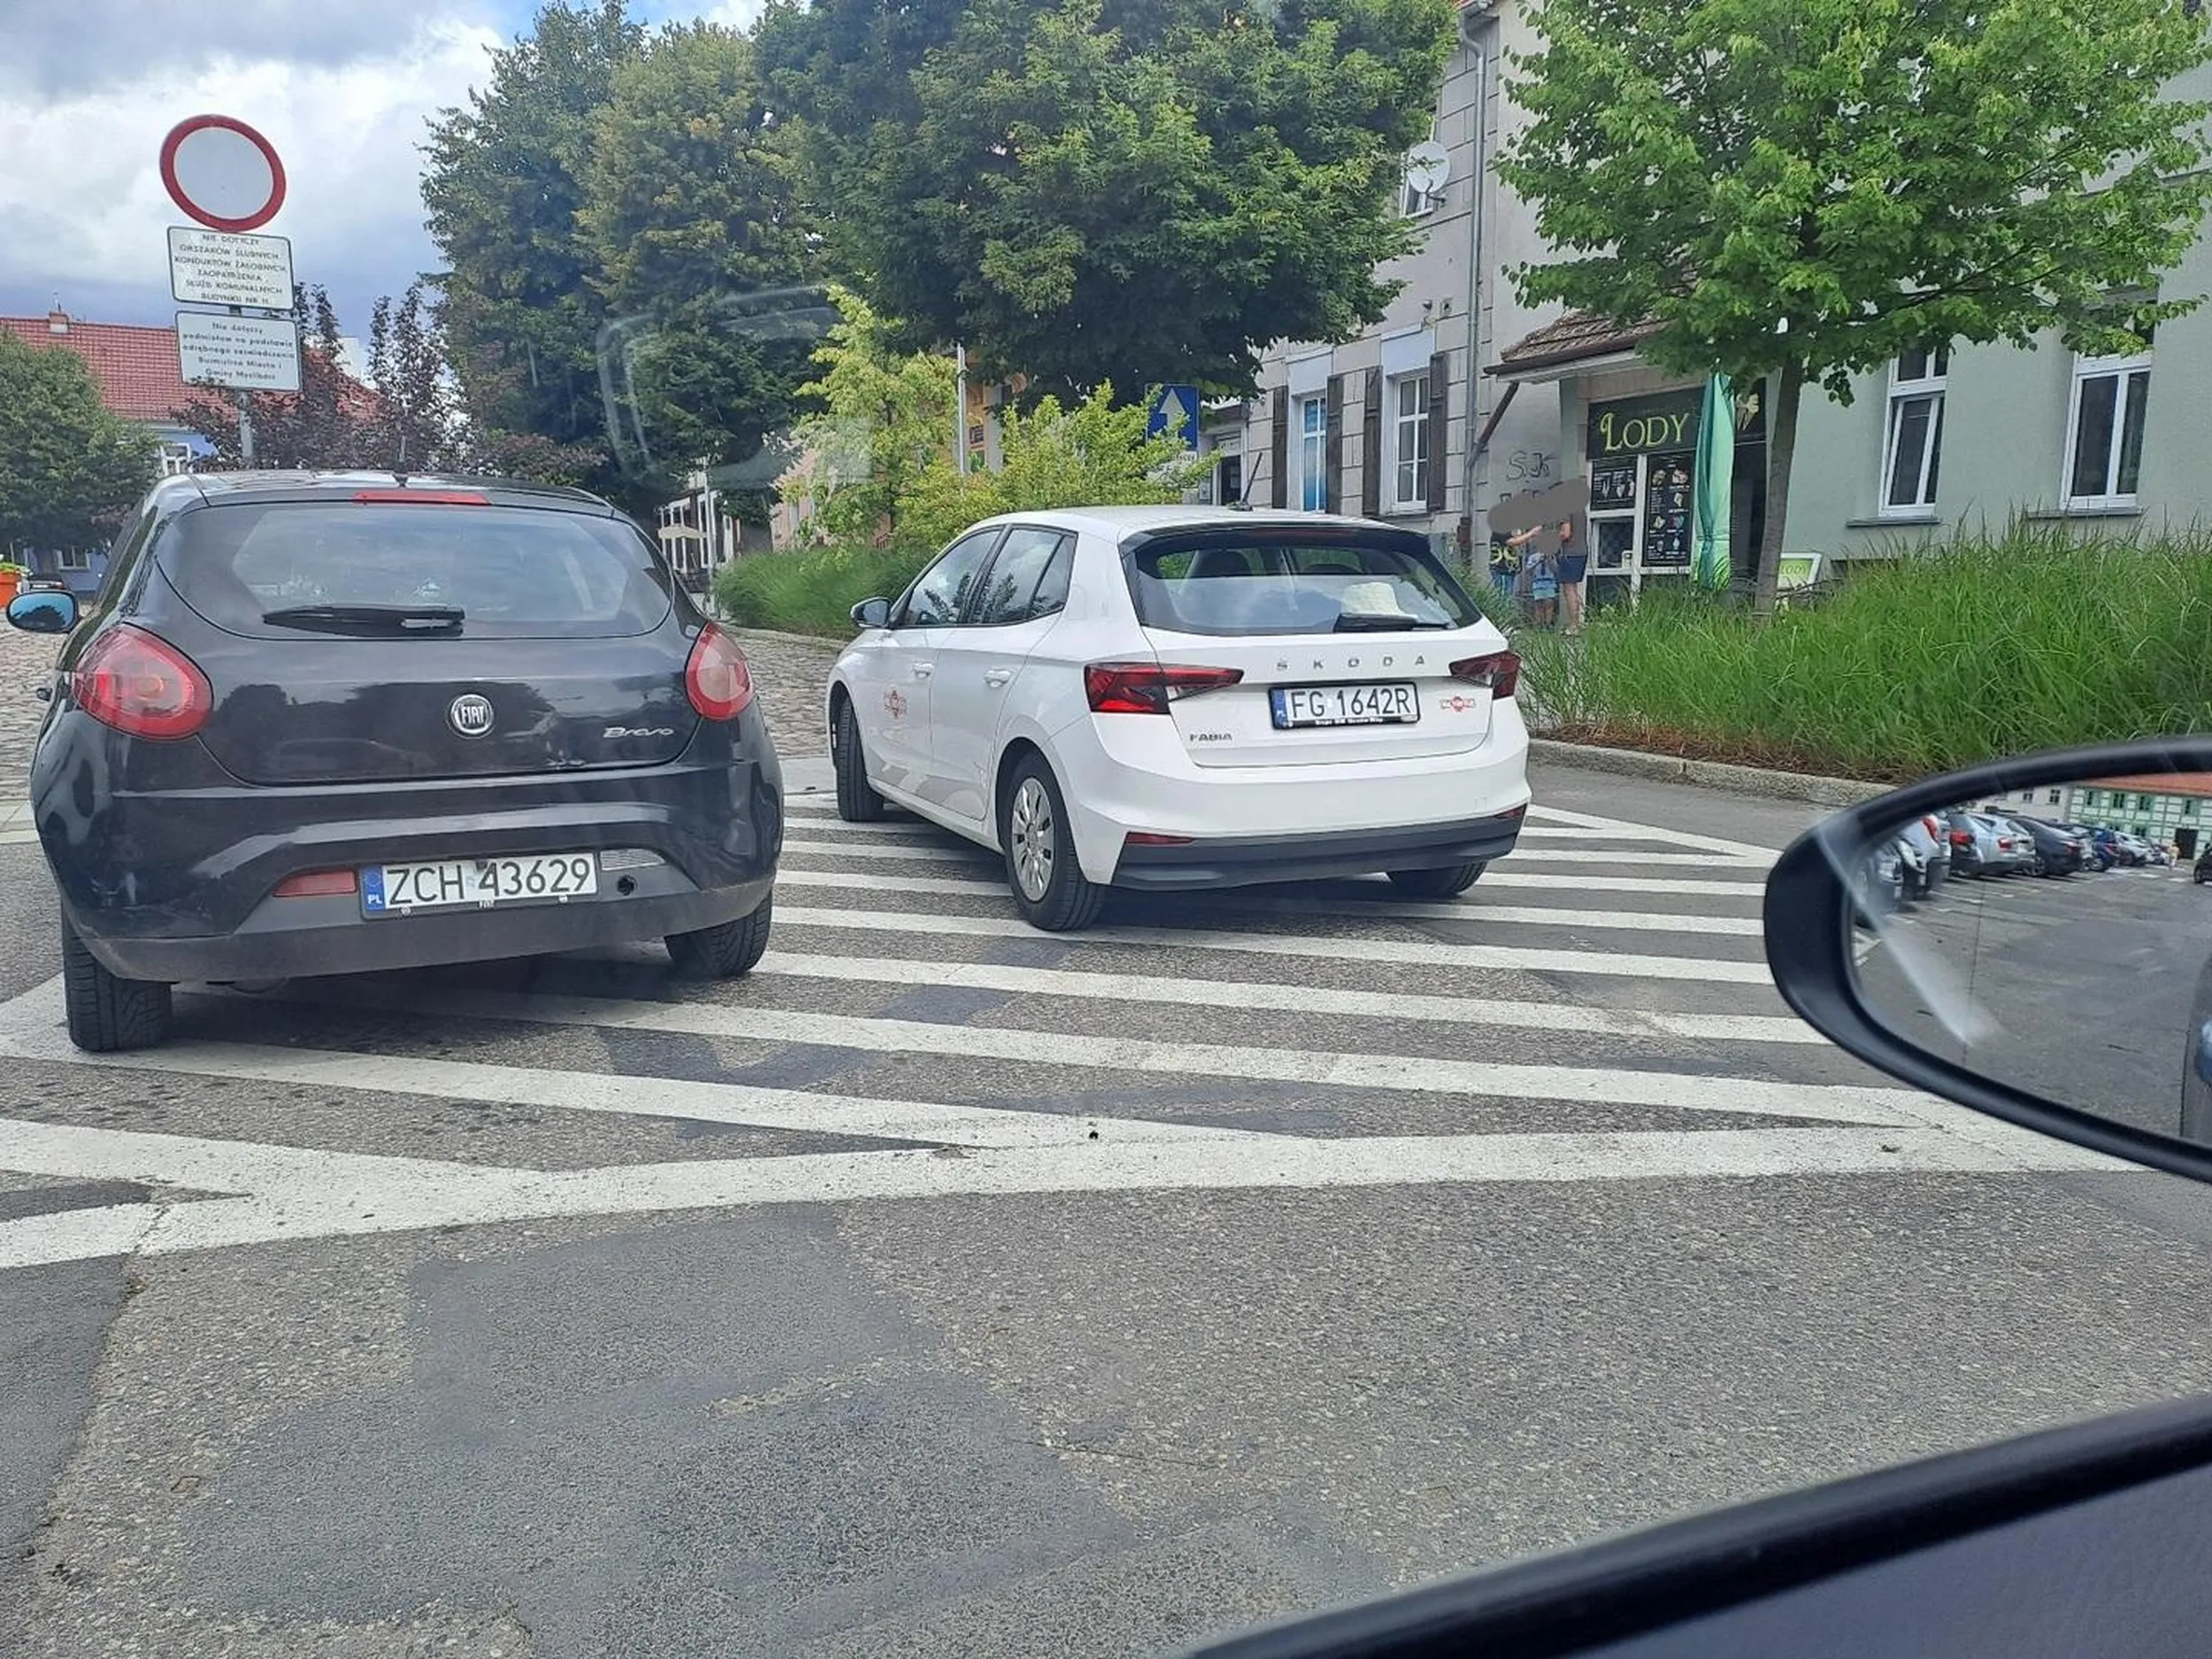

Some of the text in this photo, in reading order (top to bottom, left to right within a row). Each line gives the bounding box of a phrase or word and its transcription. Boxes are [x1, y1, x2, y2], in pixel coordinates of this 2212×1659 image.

[1600, 412, 1690, 452] LODY
[460, 706, 485, 725] FIAT
[1290, 687, 1411, 718] FG 1642R
[387, 858, 591, 906] ZCH 43629
[367, 895, 383, 904] PL
